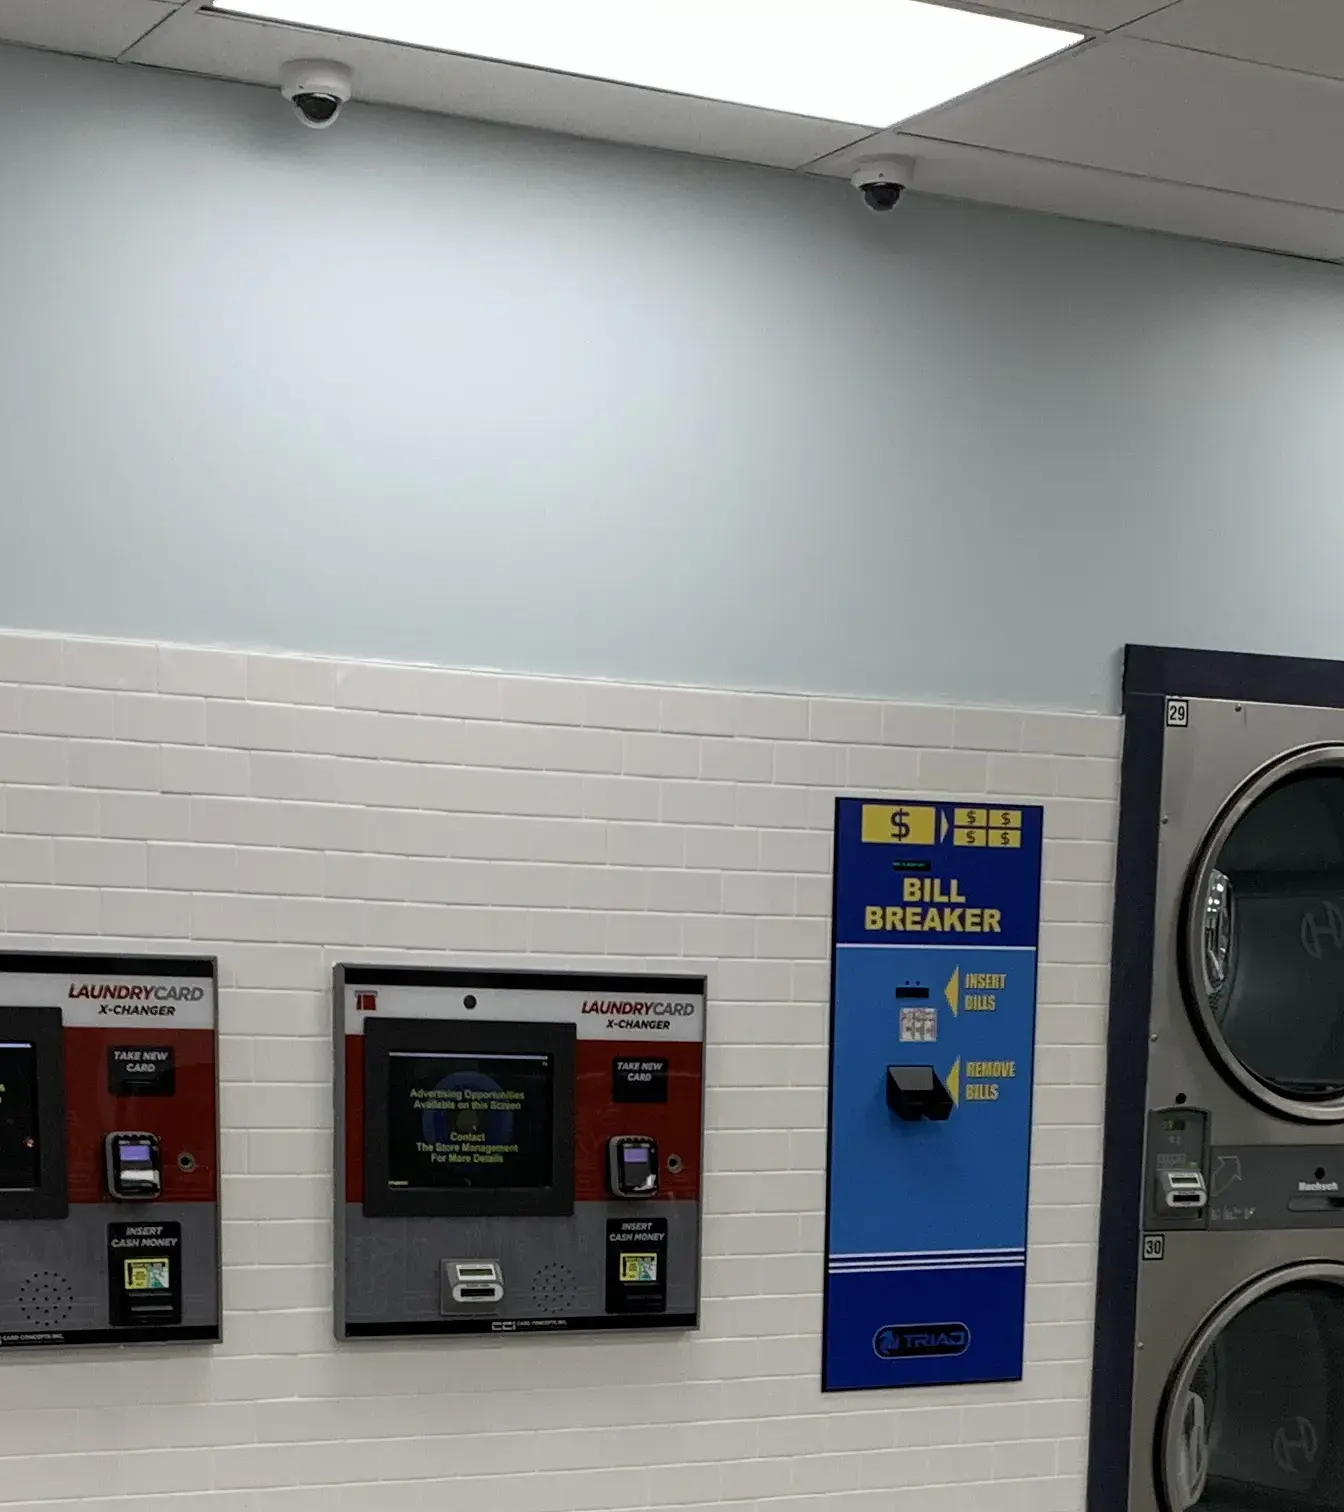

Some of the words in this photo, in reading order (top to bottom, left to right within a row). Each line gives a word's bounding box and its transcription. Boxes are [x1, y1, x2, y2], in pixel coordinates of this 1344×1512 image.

[1169, 705, 1186, 722] 29
[903, 877, 966, 904] BILL
[864, 906, 1001, 933] BREAKER
[965, 973, 1007, 989] INSERT
[68, 983, 204, 1001] LAUNDRYCARD
[581, 1000, 695, 1016] LAUNDRYCARD
[964, 994, 996, 1011] BILLS
[98, 1004, 176, 1016] X-CHANGER
[606, 1019, 670, 1030] X-CHANGER
[114, 1051, 141, 1061] TAKE
[142, 1051, 168, 1061] NEW
[126, 1063, 156, 1073] CARD
[617, 1062, 640, 1070] TAKE
[641, 1062, 663, 1071] NEW
[966, 1061, 1016, 1078] REMOVE
[627, 1072, 652, 1081] CARD
[410, 1088, 462, 1100] Advertising
[966, 1083, 999, 1100] BILLS
[450, 1131, 485, 1142] Contact
[416, 1142, 434, 1152] The
[462, 1143, 518, 1154] Management
[431, 1153, 447, 1163] For
[448, 1153, 471, 1163] More
[126, 1226, 163, 1236] INSERT
[621, 1222, 653, 1230] INSERT
[111, 1238, 140, 1248] CASH
[141, 1237, 178, 1247] MONEY
[609, 1233, 633, 1241] CASH
[634, 1232, 665, 1241] MONEY
[1146, 1239, 1162, 1255] 30
[904, 1331, 966, 1347] TRIAD
